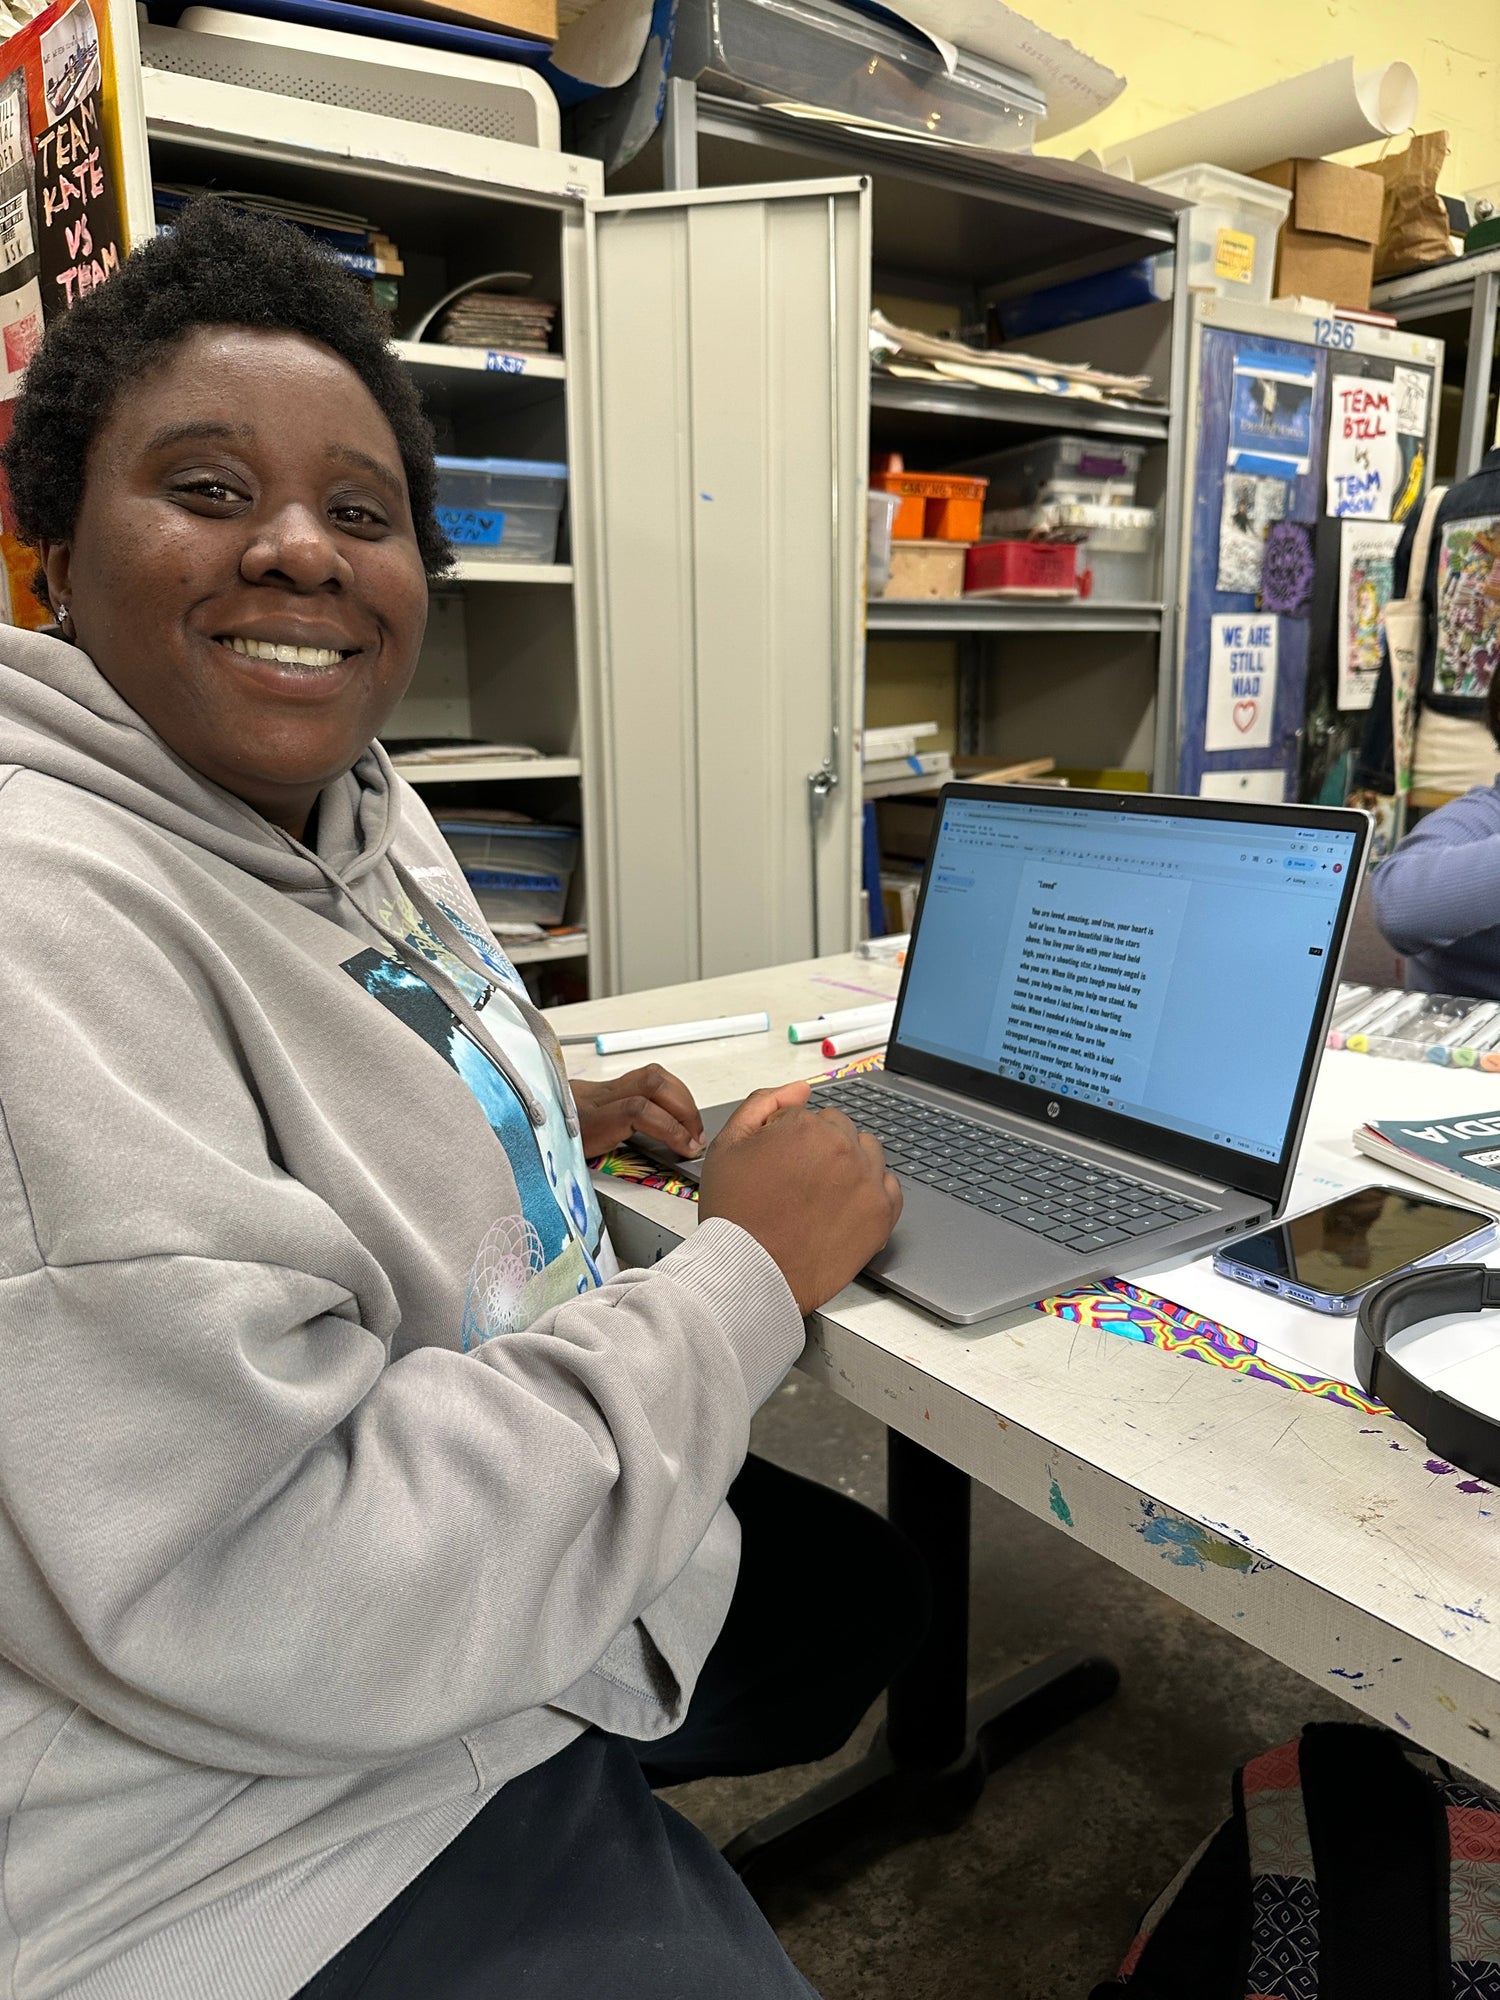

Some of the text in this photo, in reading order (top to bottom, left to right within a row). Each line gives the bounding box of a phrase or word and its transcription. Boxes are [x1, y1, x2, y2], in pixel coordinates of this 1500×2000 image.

[37, 97, 98, 178] TEAM
[43, 146, 104, 227] KATE
[65, 213, 93, 260] VS
[56, 242, 120, 310] TEAM
[1313, 317, 1355, 349] 1256
[1339, 389, 1389, 412] TEAM
[1343, 416, 1386, 439] BILL
[1334, 470, 1380, 498] TEAM
[1222, 625, 1272, 648] WE ARE
[1229, 652, 1264, 673] STILL
[1028, 921, 1038, 929] full
[1058, 926, 1067, 935] You
[1077, 930, 1102, 941] beautiful
[1103, 935, 1113, 943] like
[1114, 937, 1124, 946] the
[1125, 940, 1140, 948] stars
[1032, 907, 1040, 916] You
[1131, 924, 1147, 934] heart
[1043, 938, 1051, 946] You
[1052, 940, 1062, 948] live
[1075, 944, 1085, 953] life
[1112, 951, 1127, 961] head
[1127, 954, 1140, 964] held
[1051, 968, 1065, 978] When
[1066, 972, 1075, 980] life
[1089, 977, 1105, 988] tough
[1117, 982, 1131, 992] hold
[1131, 988, 1141, 996] my
[1057, 956, 1079, 968] shooting
[1098, 963, 1123, 977] heavenly
[1123, 970, 1140, 980] angel
[1140, 972, 1146, 980] is
[1014, 990, 1027, 998] came
[1028, 992, 1033, 1000] to
[1043, 996, 1056, 1005] when
[1060, 999, 1071, 1009] lost
[1089, 1008, 1100, 1016] was
[1100, 1009, 1122, 1023] hurting
[1041, 981, 1052, 991] help
[1085, 991, 1097, 1001] help
[1098, 995, 1107, 1003] me
[1127, 1000, 1138, 1009] You
[1020, 1020, 1032, 1028] arms
[1034, 1024, 1045, 1032] were
[1046, 1027, 1059, 1036] open
[1075, 1033, 1085, 1042] You
[1085, 1037, 1095, 1045] are
[1096, 1039, 1105, 1048] the
[1028, 1006, 1042, 1016] When
[1046, 1012, 1065, 1022] needed
[1070, 1017, 1087, 1027] friend
[1087, 1021, 1093, 1029] to
[1094, 1023, 1109, 1033] show
[1109, 1028, 1118, 1036] me
[1119, 1029, 1132, 1039] love
[1005, 1030, 1029, 1041] strongest
[1029, 1036, 1047, 1046] person
[1083, 1051, 1095, 1060] with
[1101, 1055, 1115, 1065] kind
[1002, 1042, 1017, 1054] loving
[1018, 1046, 1032, 1057] heart
[1040, 1055, 1055, 1063] never
[1092, 1067, 1099, 1078] by
[1099, 1072, 1109, 1080] my
[1110, 1074, 1122, 1083] side
[1039, 1069, 1047, 1078] my
[1065, 1076, 1075, 1084] you
[1076, 1078, 1089, 1088] show
[1100, 1086, 1110, 1095] the
